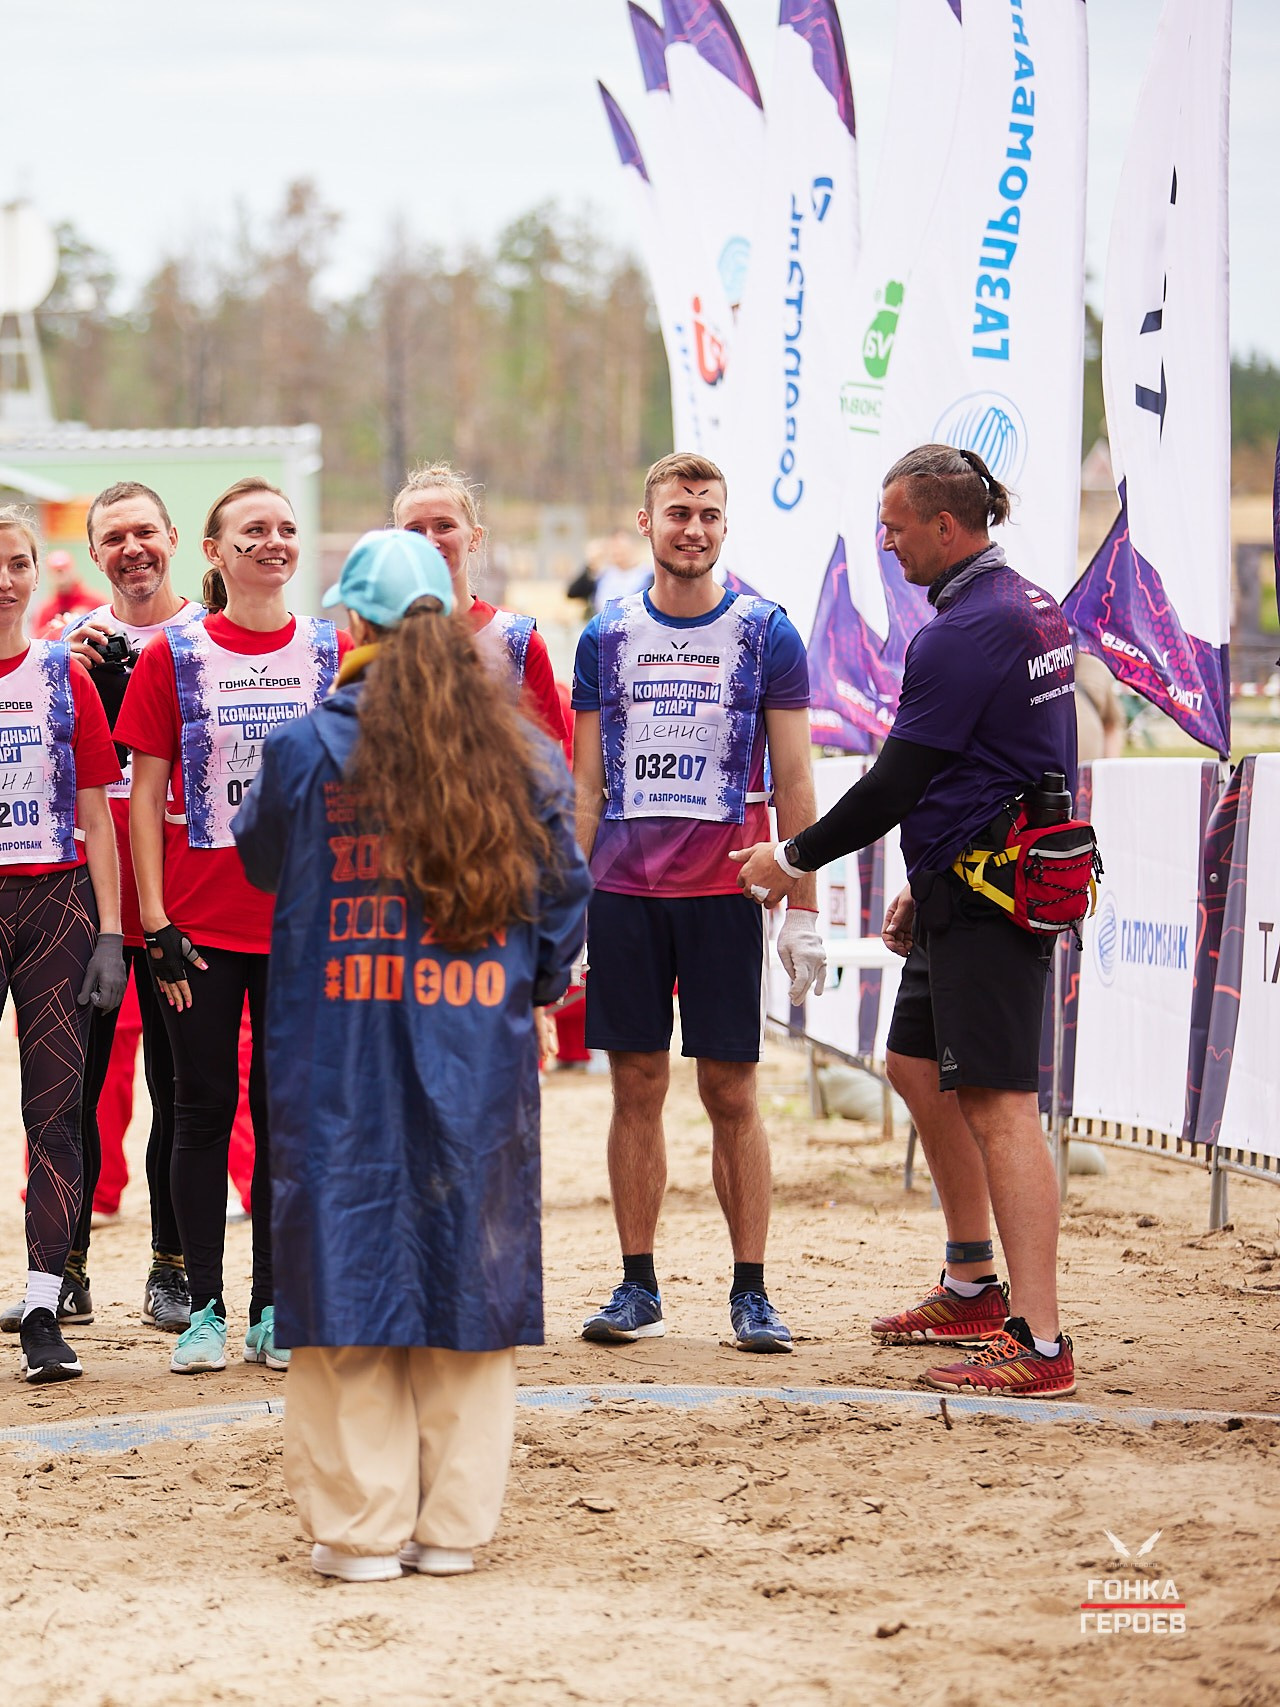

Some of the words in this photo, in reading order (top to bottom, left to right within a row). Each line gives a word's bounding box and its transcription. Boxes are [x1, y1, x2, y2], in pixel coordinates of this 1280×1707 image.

[637, 653, 674, 664] ГОНКА
[677, 653, 720, 665] ГЕРОЕВ
[1028, 644, 1075, 680] ИНСТРУКТ
[219, 678, 256, 689] ГОНКА
[259, 677, 301, 687] ГЕРОЕВ
[634, 682, 720, 701] КОМАНДНЫЙ
[219, 702, 307, 723] КОМАНДНЫЙ
[655, 700, 695, 715] СТАРТ
[635, 753, 707, 782] 03207
[649, 793, 707, 806] ГАЗПРОМБАНК
